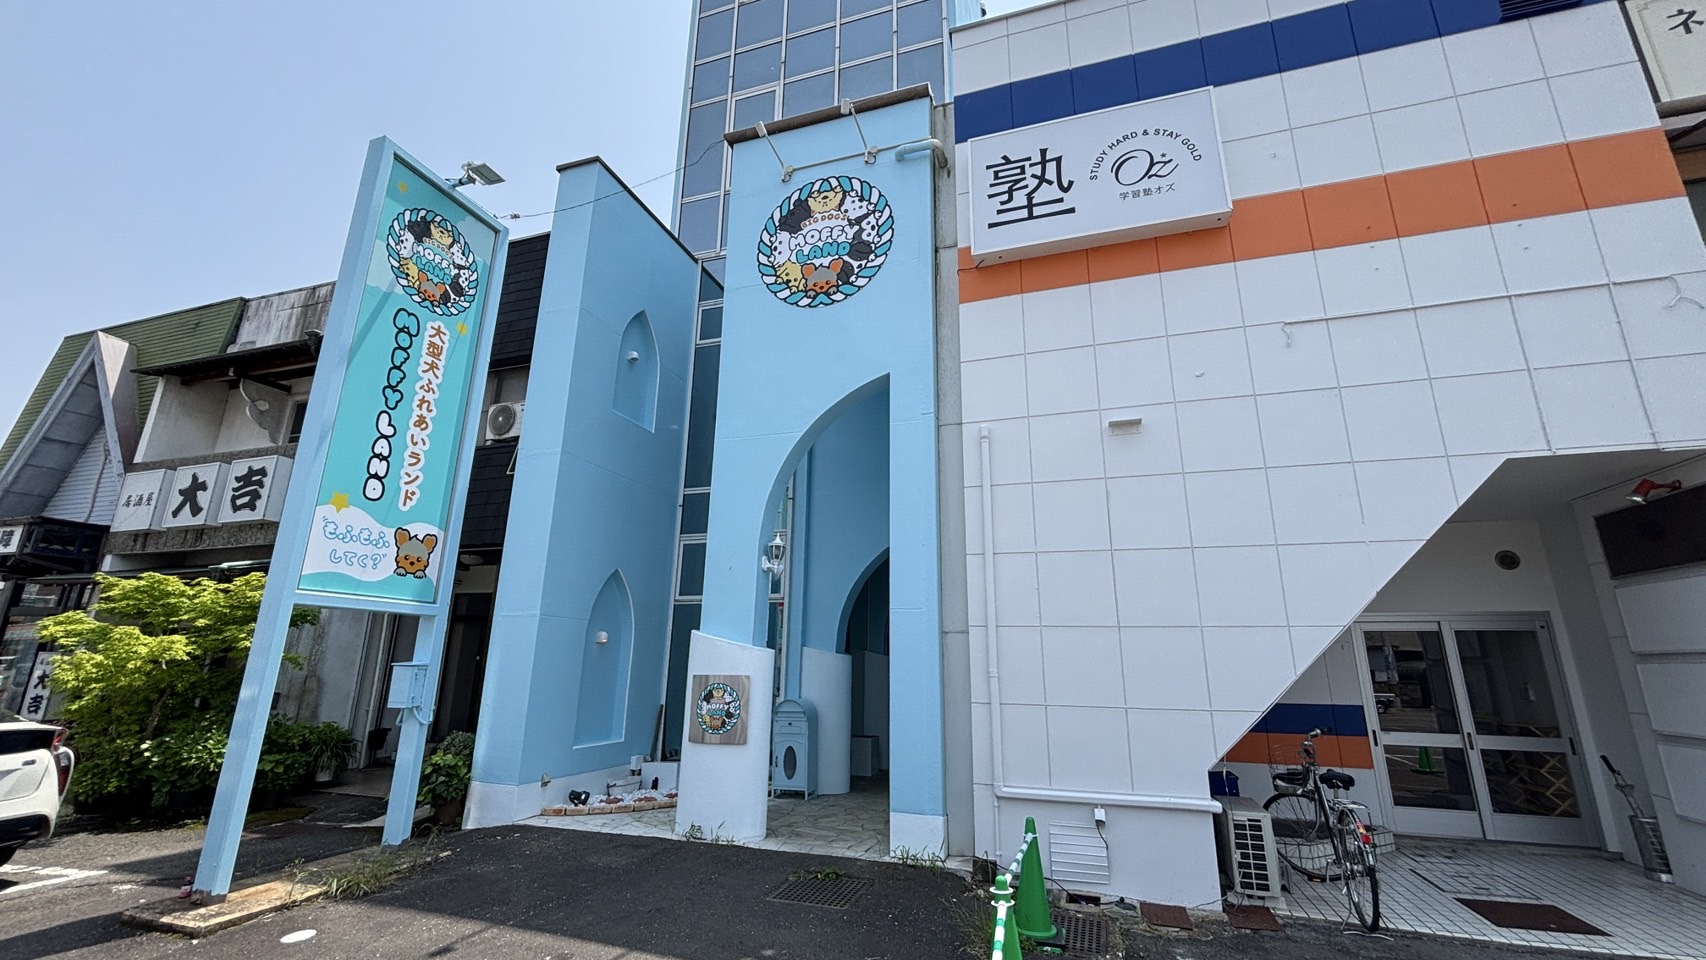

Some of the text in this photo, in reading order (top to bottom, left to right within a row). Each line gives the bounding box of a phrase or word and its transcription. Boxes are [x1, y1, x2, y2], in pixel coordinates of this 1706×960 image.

[1665, 8, 1705, 35] ネ
[1089, 128, 1203, 181] STUDY HARD & STAY GOLD
[985, 147, 1076, 230] 塾
[788, 224, 860, 251] MOFFY
[802, 213, 848, 229] BIG DOGS
[412, 241, 459, 277] MOFFY
[796, 240, 851, 264] LAND
[415, 255, 452, 285] LAND
[362, 307, 421, 502] MOFFY LAND
[402, 324, 447, 507] 大型犬ふれあいランド
[121, 491, 155, 508] 居酒屋
[171, 466, 267, 518] 大吉
